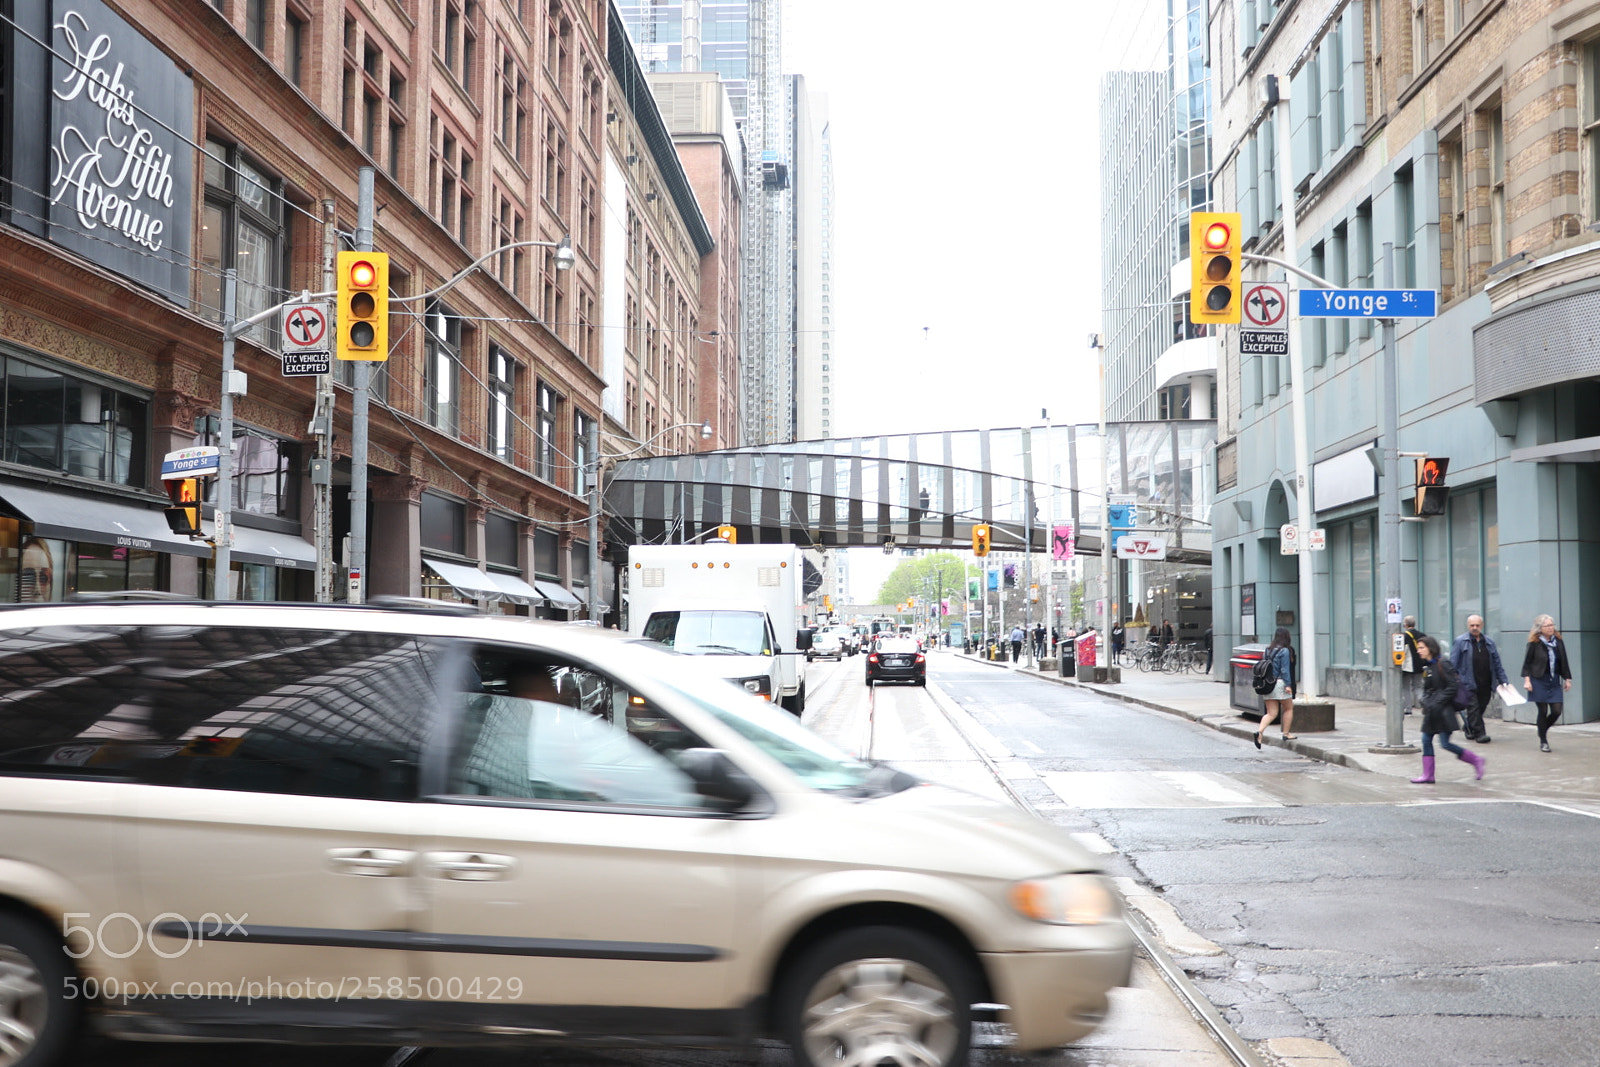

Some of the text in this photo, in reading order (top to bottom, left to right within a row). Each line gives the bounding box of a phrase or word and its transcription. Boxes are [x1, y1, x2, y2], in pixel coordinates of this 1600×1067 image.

[53, 11, 135, 126] Saks
[96, 110, 173, 208] Fifth
[51, 127, 163, 251] Avenue
[1322, 291, 1388, 315] Yonge
[1241, 333, 1288, 343] TTC VEHICLES
[1242, 343, 1285, 352] EXCEPTED
[284, 354, 329, 363] TTC VEHICLES
[286, 364, 327, 373] EXCEPTED
[173, 457, 208, 469] Yonge St
[117, 536, 152, 548] LOUIS VUITTON
